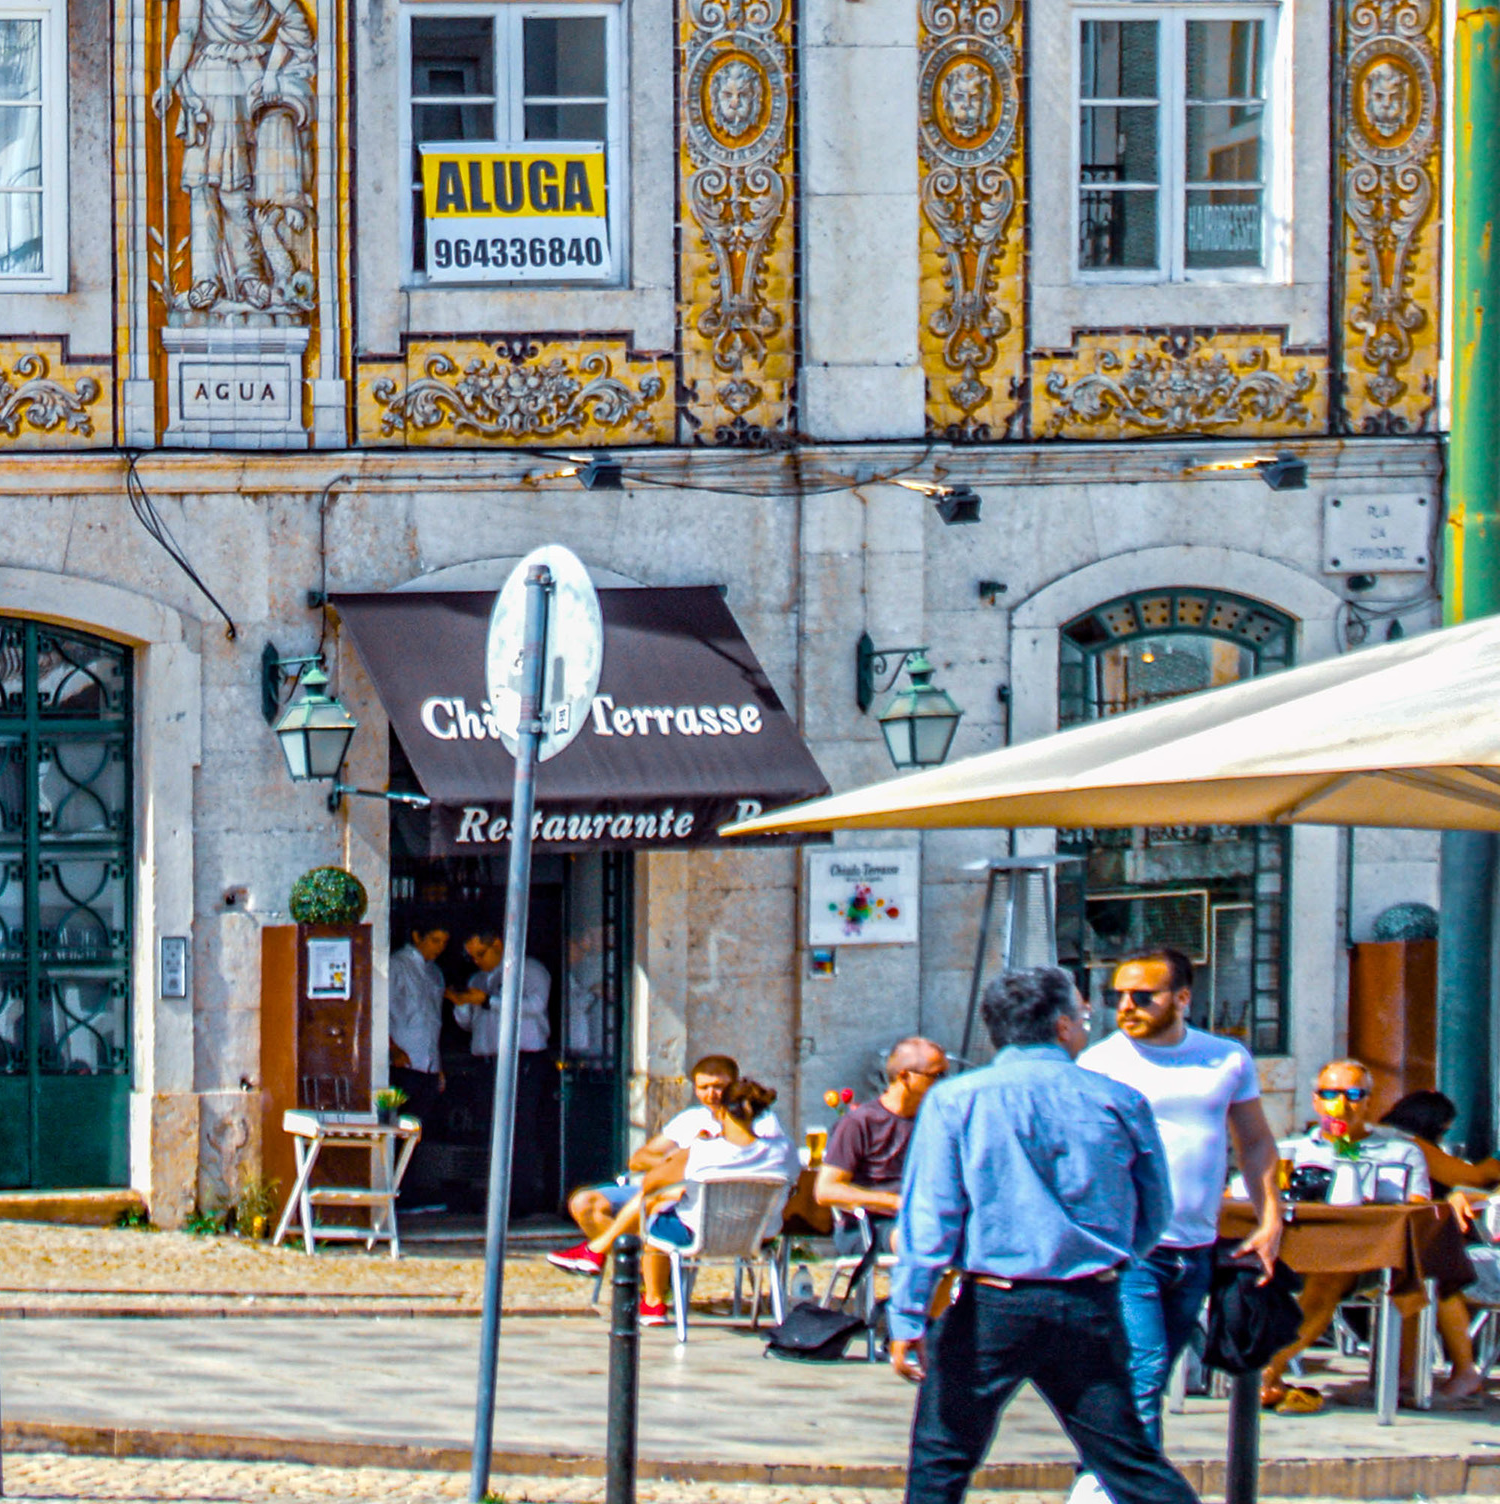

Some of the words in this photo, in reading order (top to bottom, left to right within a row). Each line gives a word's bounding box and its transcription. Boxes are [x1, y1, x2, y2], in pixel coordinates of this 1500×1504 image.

[435, 160, 595, 213] ALUGA
[434, 237, 604, 269] 964336840
[194, 382, 276, 401] AGUA
[591, 693, 763, 737] Terrasse
